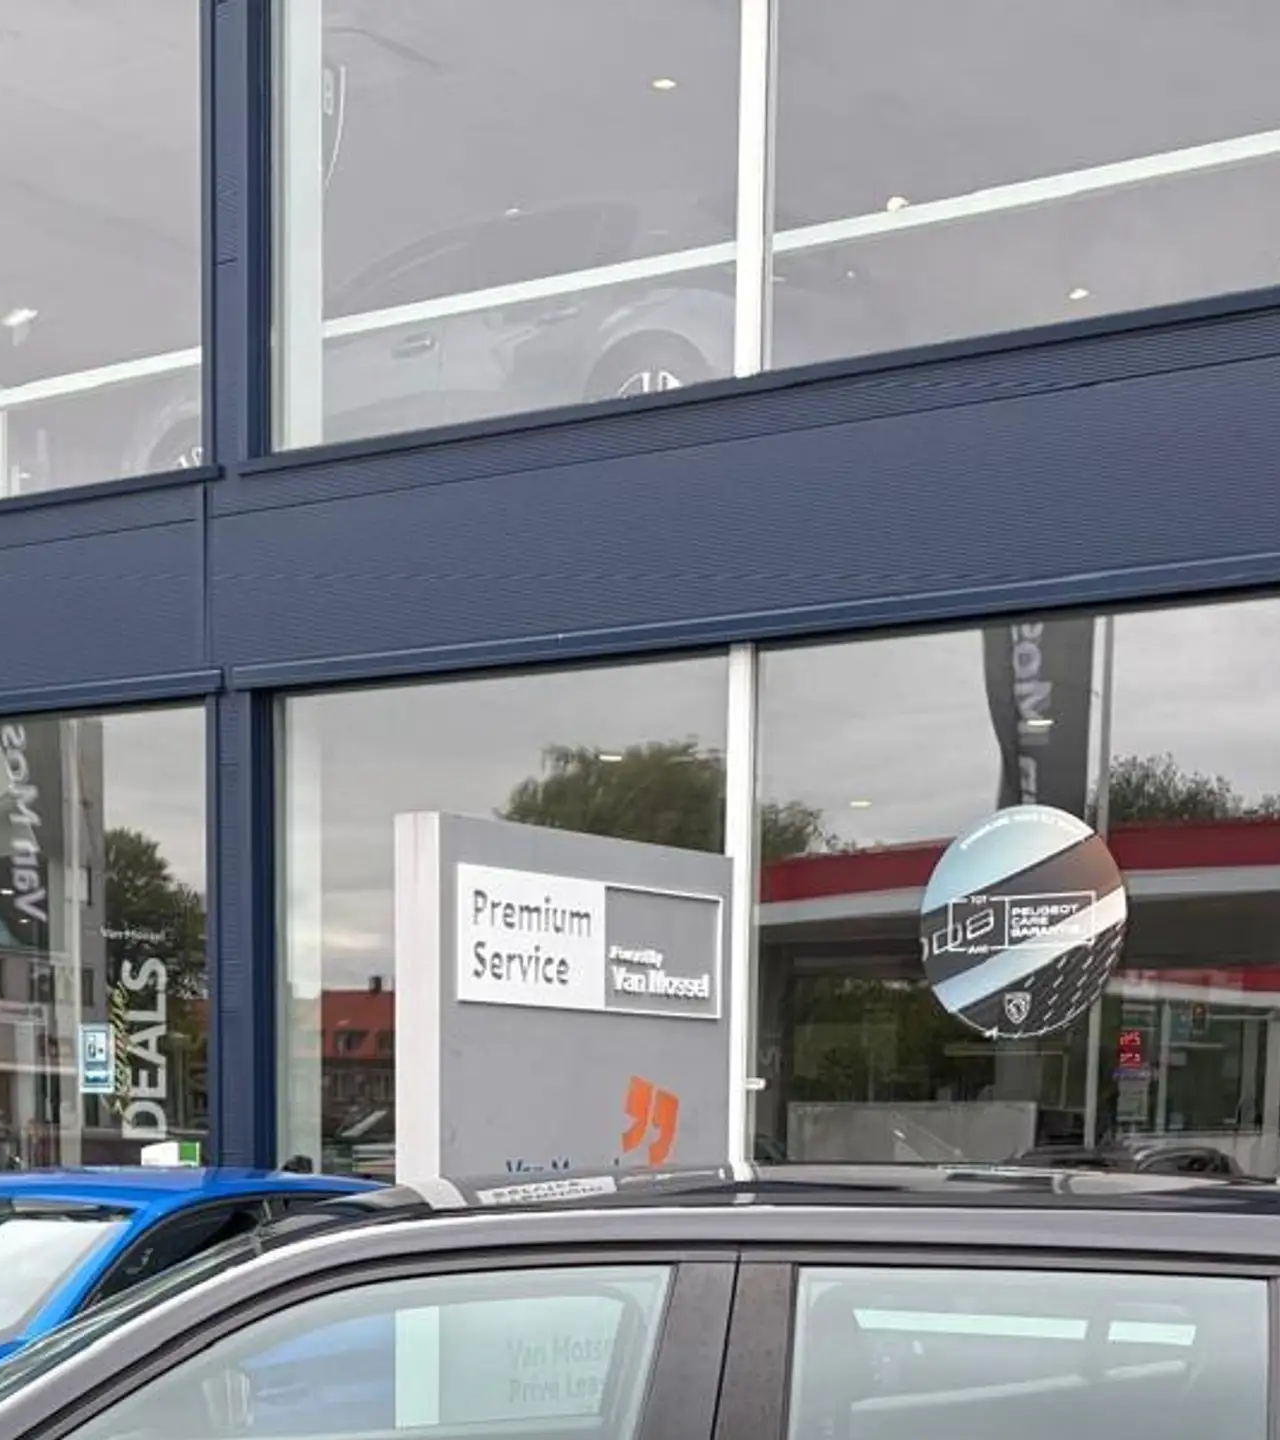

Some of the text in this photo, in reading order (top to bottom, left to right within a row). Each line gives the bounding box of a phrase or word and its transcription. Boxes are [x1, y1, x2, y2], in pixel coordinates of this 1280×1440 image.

[472, 888, 592, 938] Premium
[1011, 903, 1080, 916] PEUGEOT
[472, 941, 570, 986] Service
[612, 966, 710, 998] Van Mossel
[121, 957, 168, 1139] DEALS
